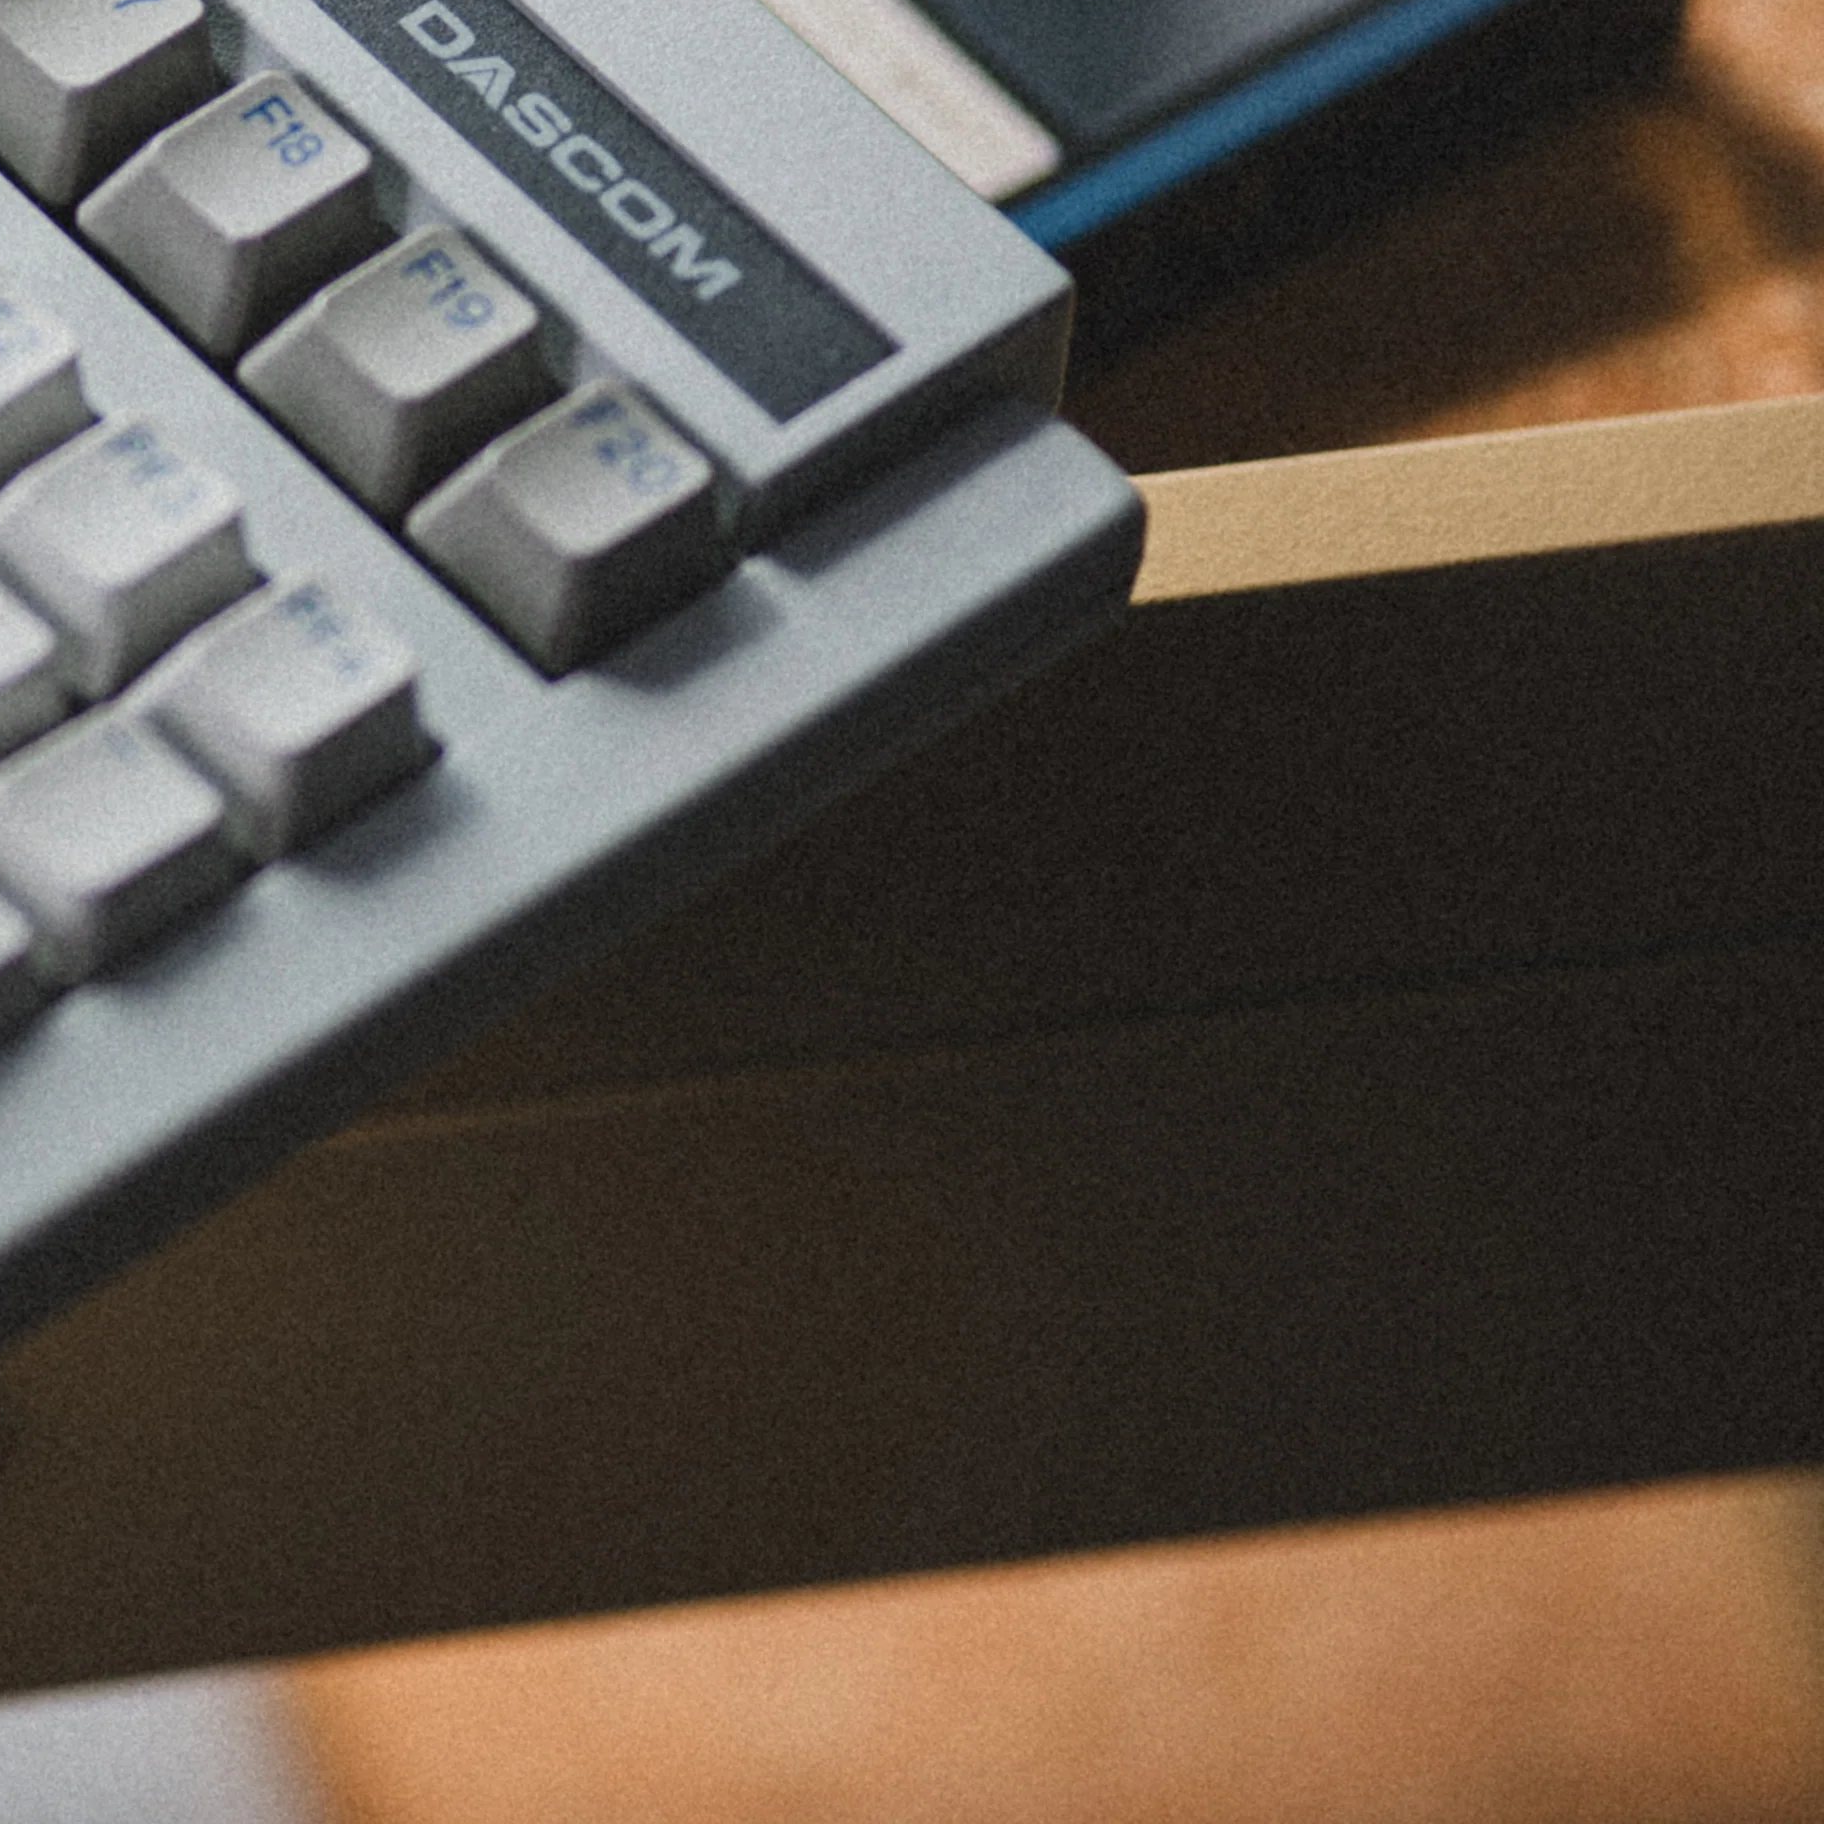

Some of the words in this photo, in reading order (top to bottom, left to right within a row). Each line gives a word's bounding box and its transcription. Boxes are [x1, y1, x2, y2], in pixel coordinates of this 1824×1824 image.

[241, 94, 325, 166] F18
[406, 248, 496, 332] F19
[572, 396, 682, 497] F20
